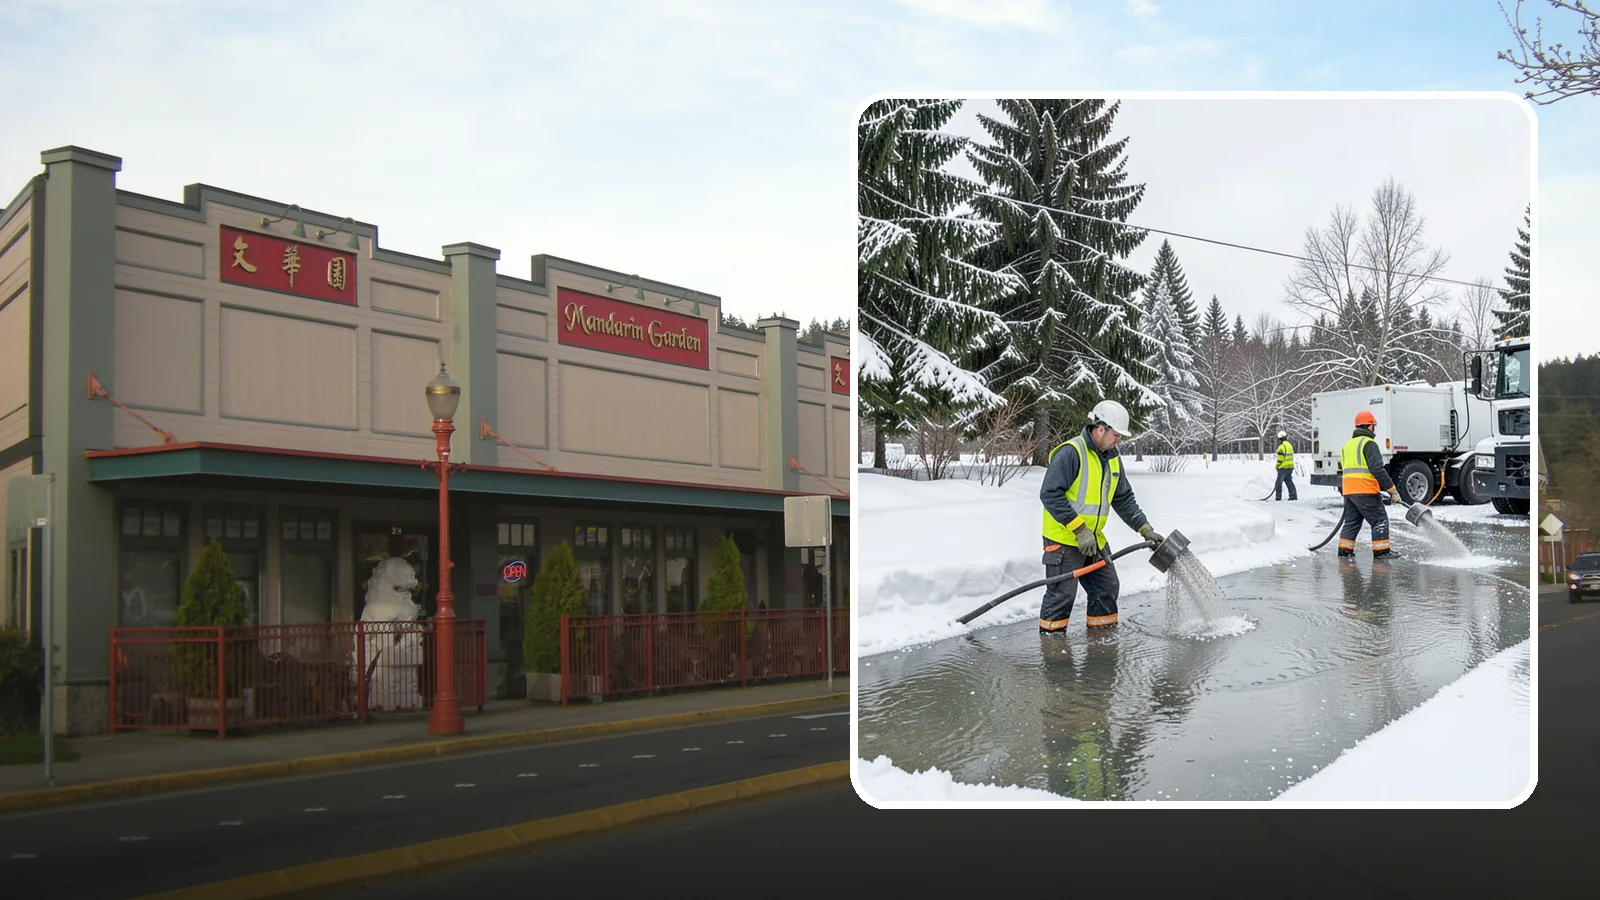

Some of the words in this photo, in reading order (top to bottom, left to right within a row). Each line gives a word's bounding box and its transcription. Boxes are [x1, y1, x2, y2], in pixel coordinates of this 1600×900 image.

[231, 235, 346, 291] 文華園
[565, 302, 644, 341] Mandarin
[648, 320, 701, 352] Garden
[503, 565, 527, 578] OPEN
